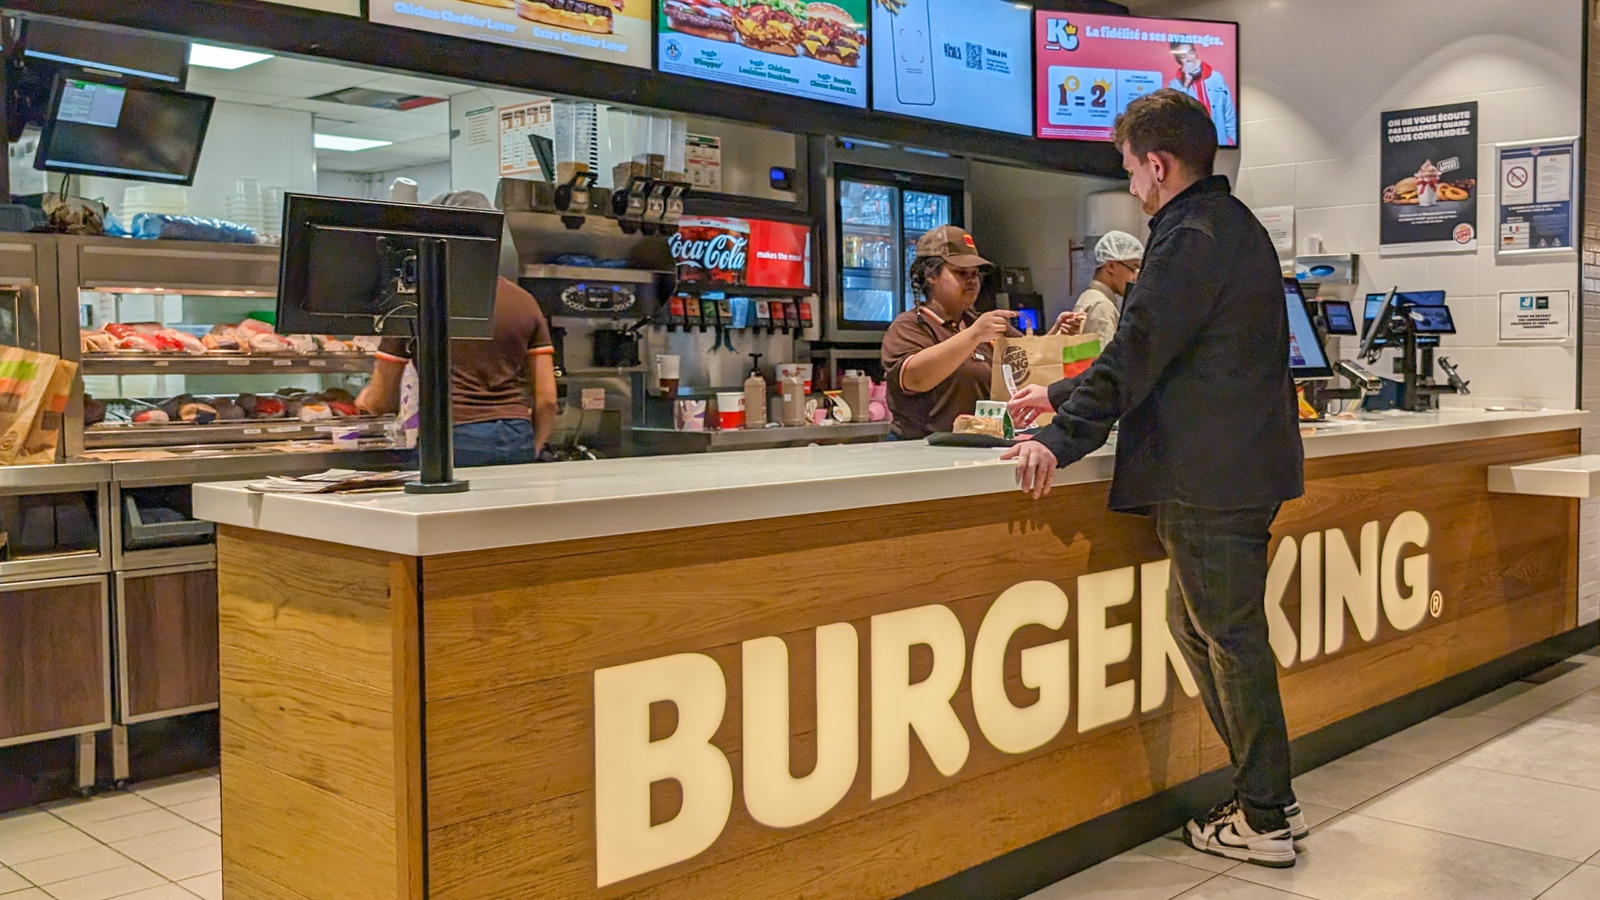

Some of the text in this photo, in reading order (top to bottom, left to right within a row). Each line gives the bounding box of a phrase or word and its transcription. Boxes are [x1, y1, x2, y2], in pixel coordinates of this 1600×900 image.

[394, 2, 516, 33] Chicken Cheddar Lover
[533, 27, 560, 41] Extra
[561, 32, 601, 48] Cheddar
[601, 39, 628, 53] Lover
[1086, 26, 1223, 47] La fidélité a ses avantages.
[768, 63, 791, 75] Chicken
[768, 71, 799, 84] Steakhouse
[810, 80, 857, 95] Cheese Bacon XXL
[1058, 84, 1068, 106] 1
[1091, 85, 1106, 108] 2
[1402, 118, 1413, 126] NE
[1414, 115, 1436, 124] VOUS
[1438, 111, 1471, 121] ÉCOUTE
[1403, 123, 1441, 133] SEULEMENT
[1443, 120, 1470, 128] QUAND
[1389, 128, 1470, 143] VOUS COMMANDEZ.
[757, 251, 777, 260] makes
[778, 252, 788, 260] the
[594, 559, 1200, 888] BURGER
